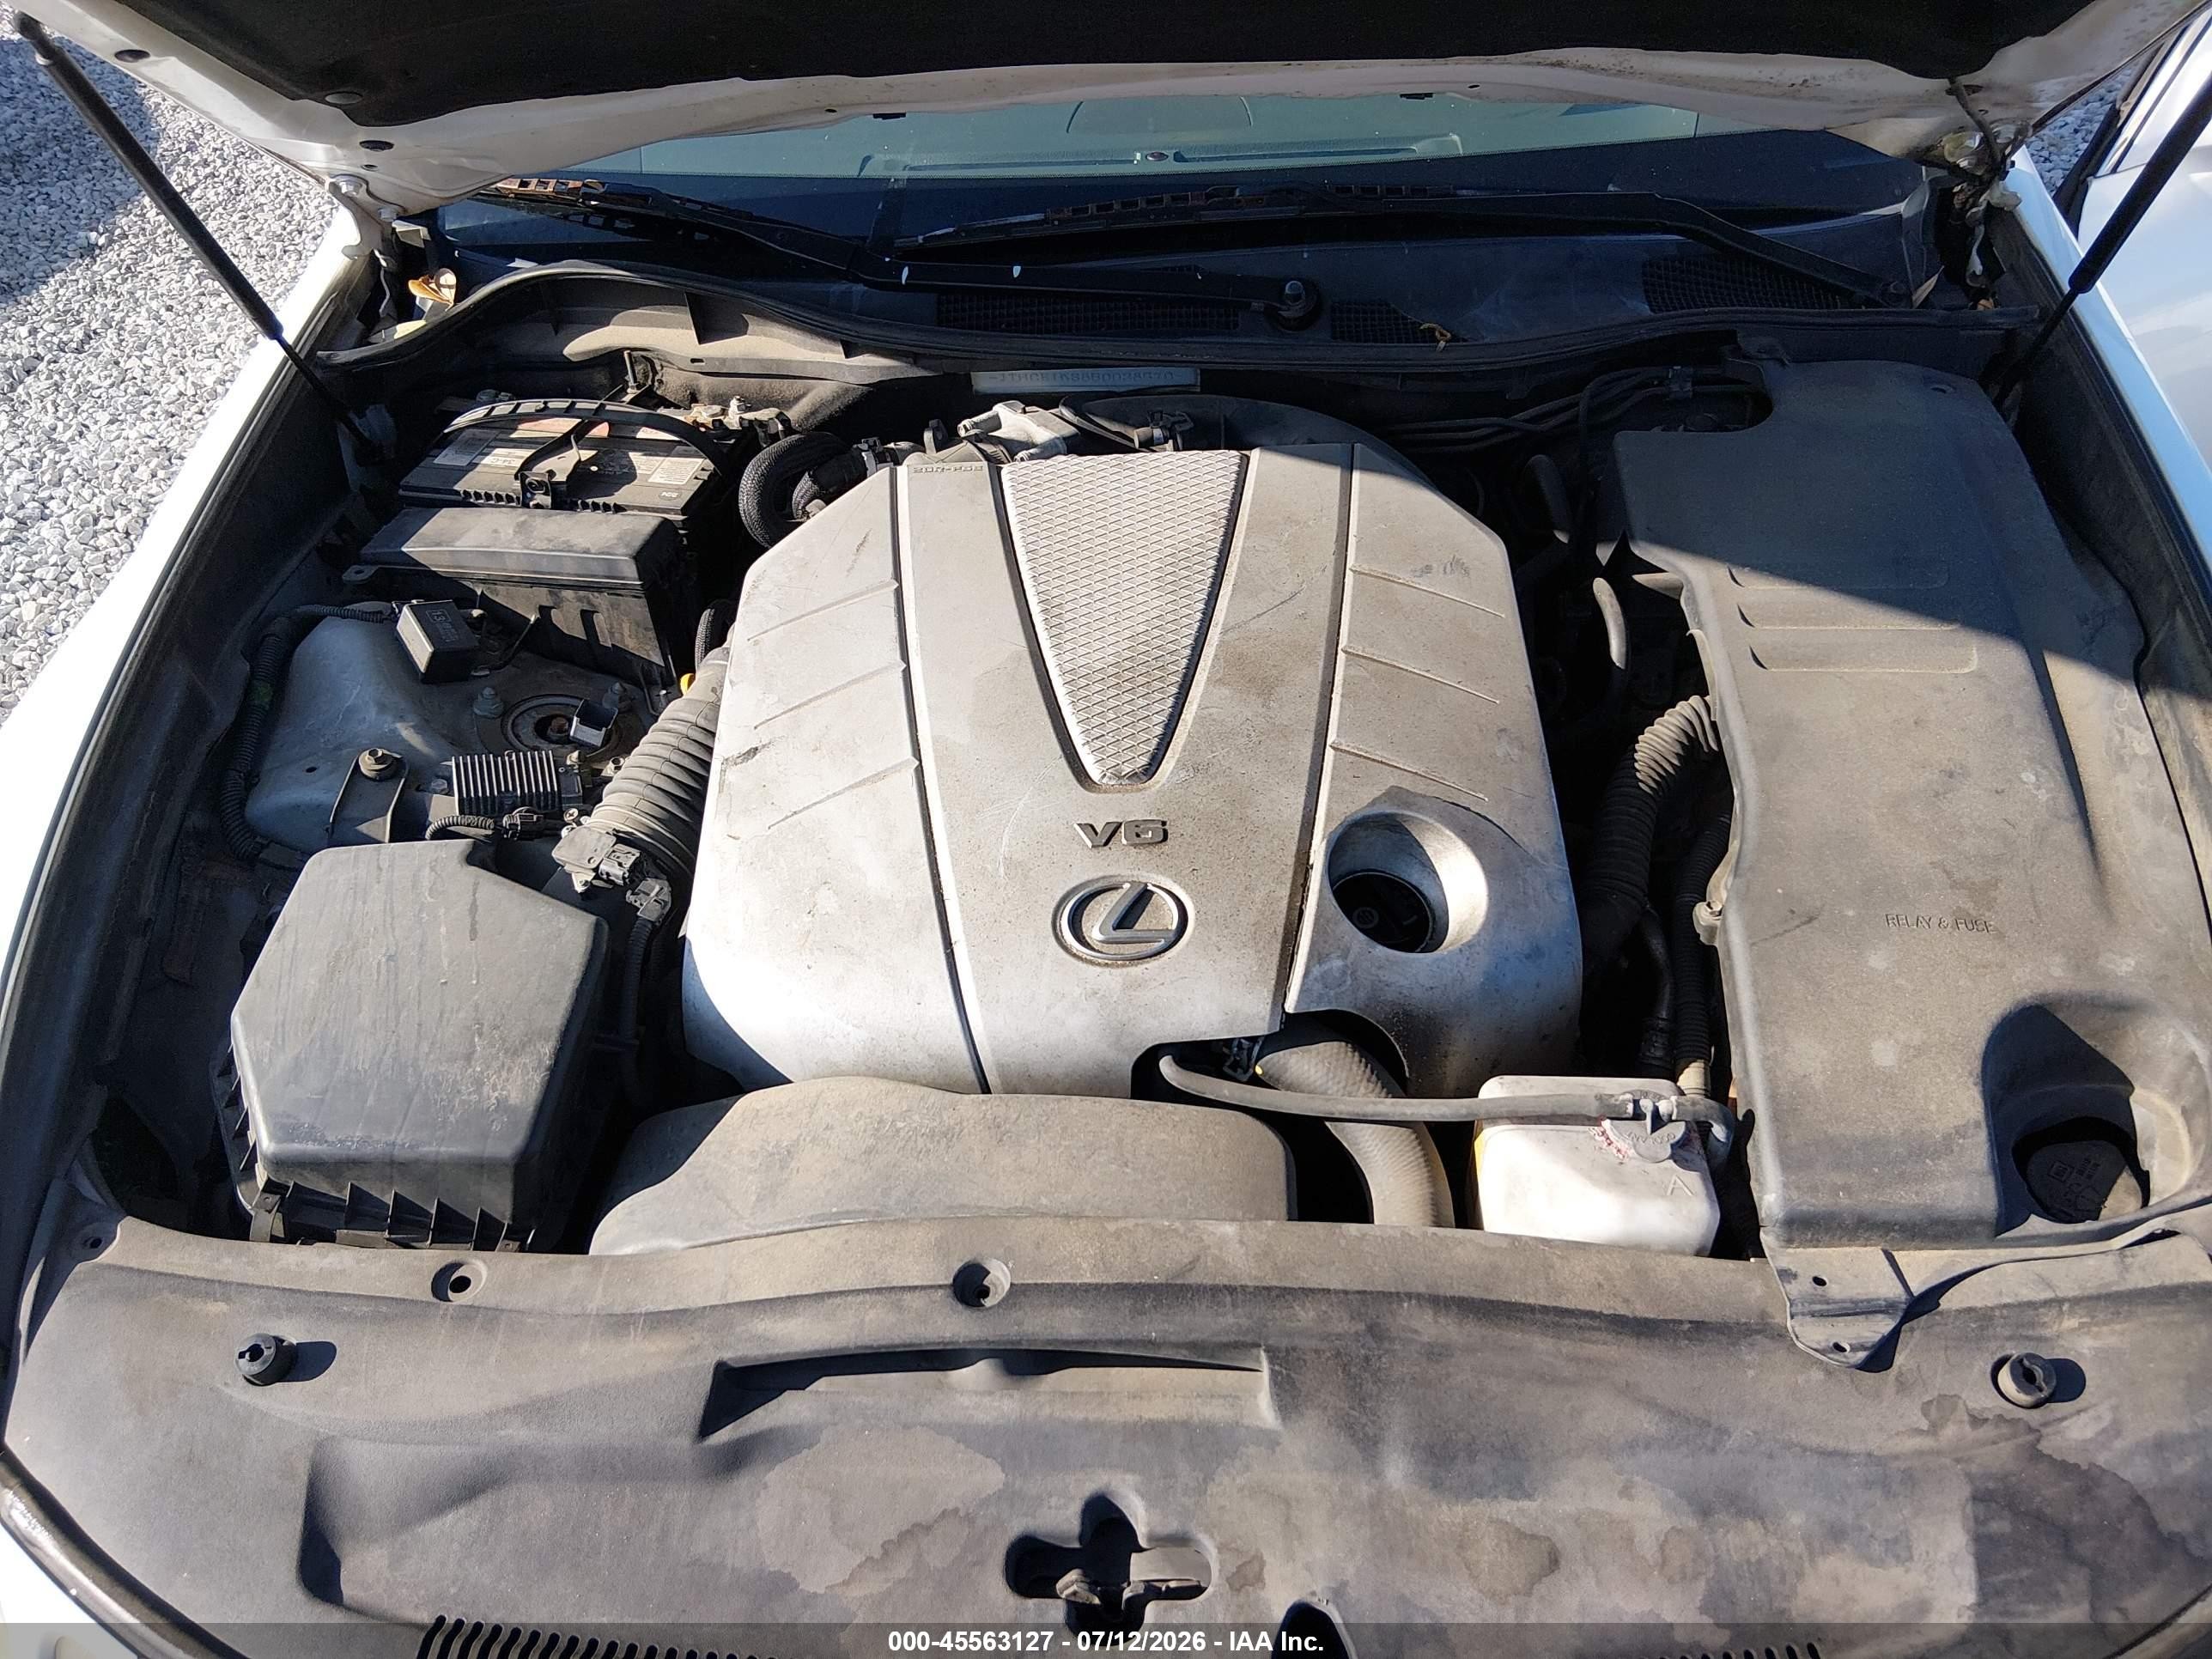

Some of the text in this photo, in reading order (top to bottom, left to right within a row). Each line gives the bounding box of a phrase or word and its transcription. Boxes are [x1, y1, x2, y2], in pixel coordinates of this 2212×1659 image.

[1073, 819, 1169, 848] V6
[1885, 914, 1998, 933] RELAY & FUSE
